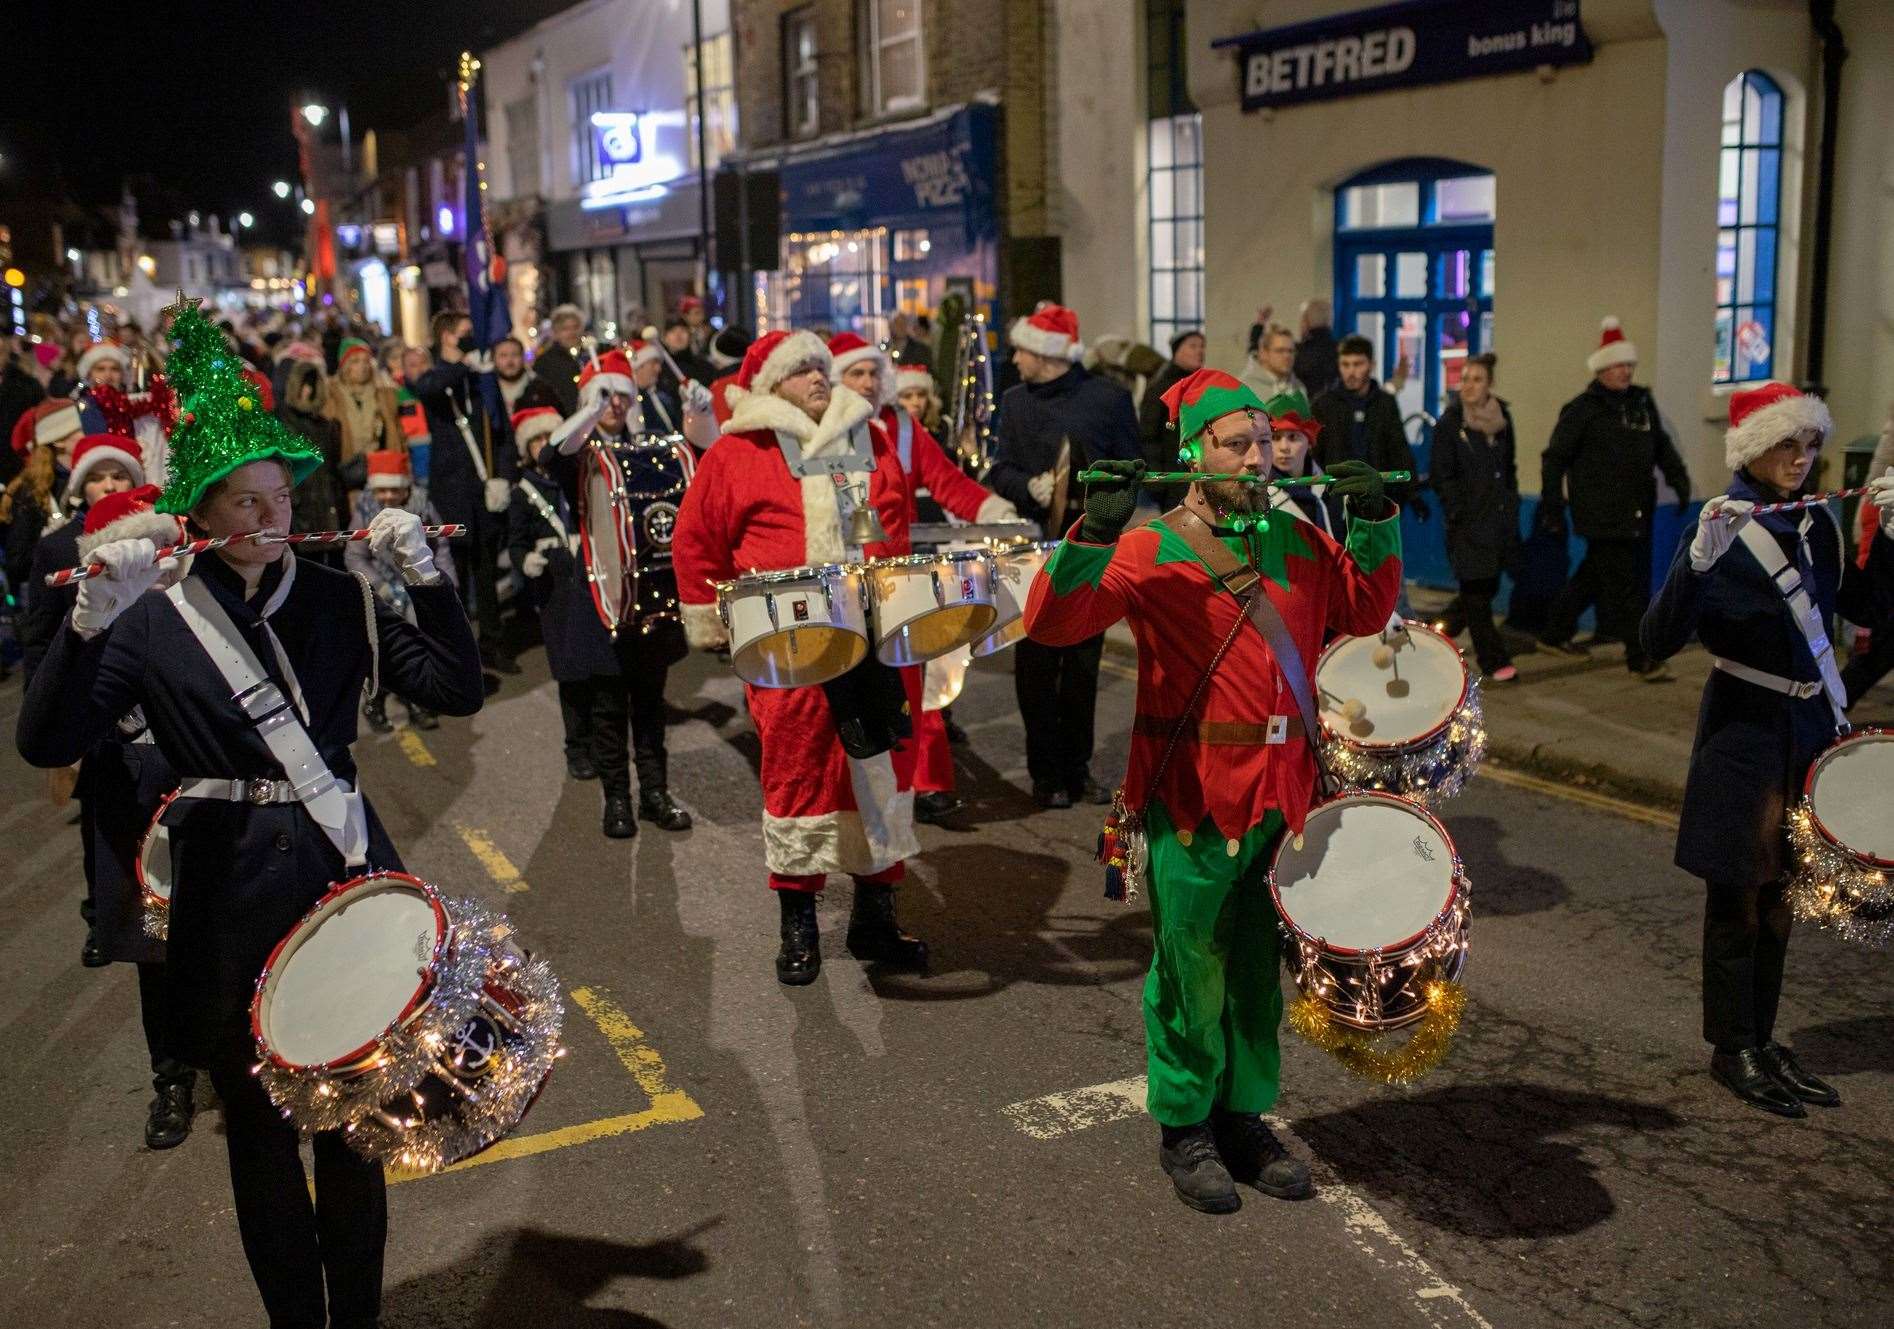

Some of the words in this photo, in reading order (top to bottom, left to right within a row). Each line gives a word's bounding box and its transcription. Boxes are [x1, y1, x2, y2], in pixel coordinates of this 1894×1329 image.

[1245, 28, 1417, 98] BETFRED
[1467, 31, 1527, 57] bonus
[1531, 21, 1576, 46] king
